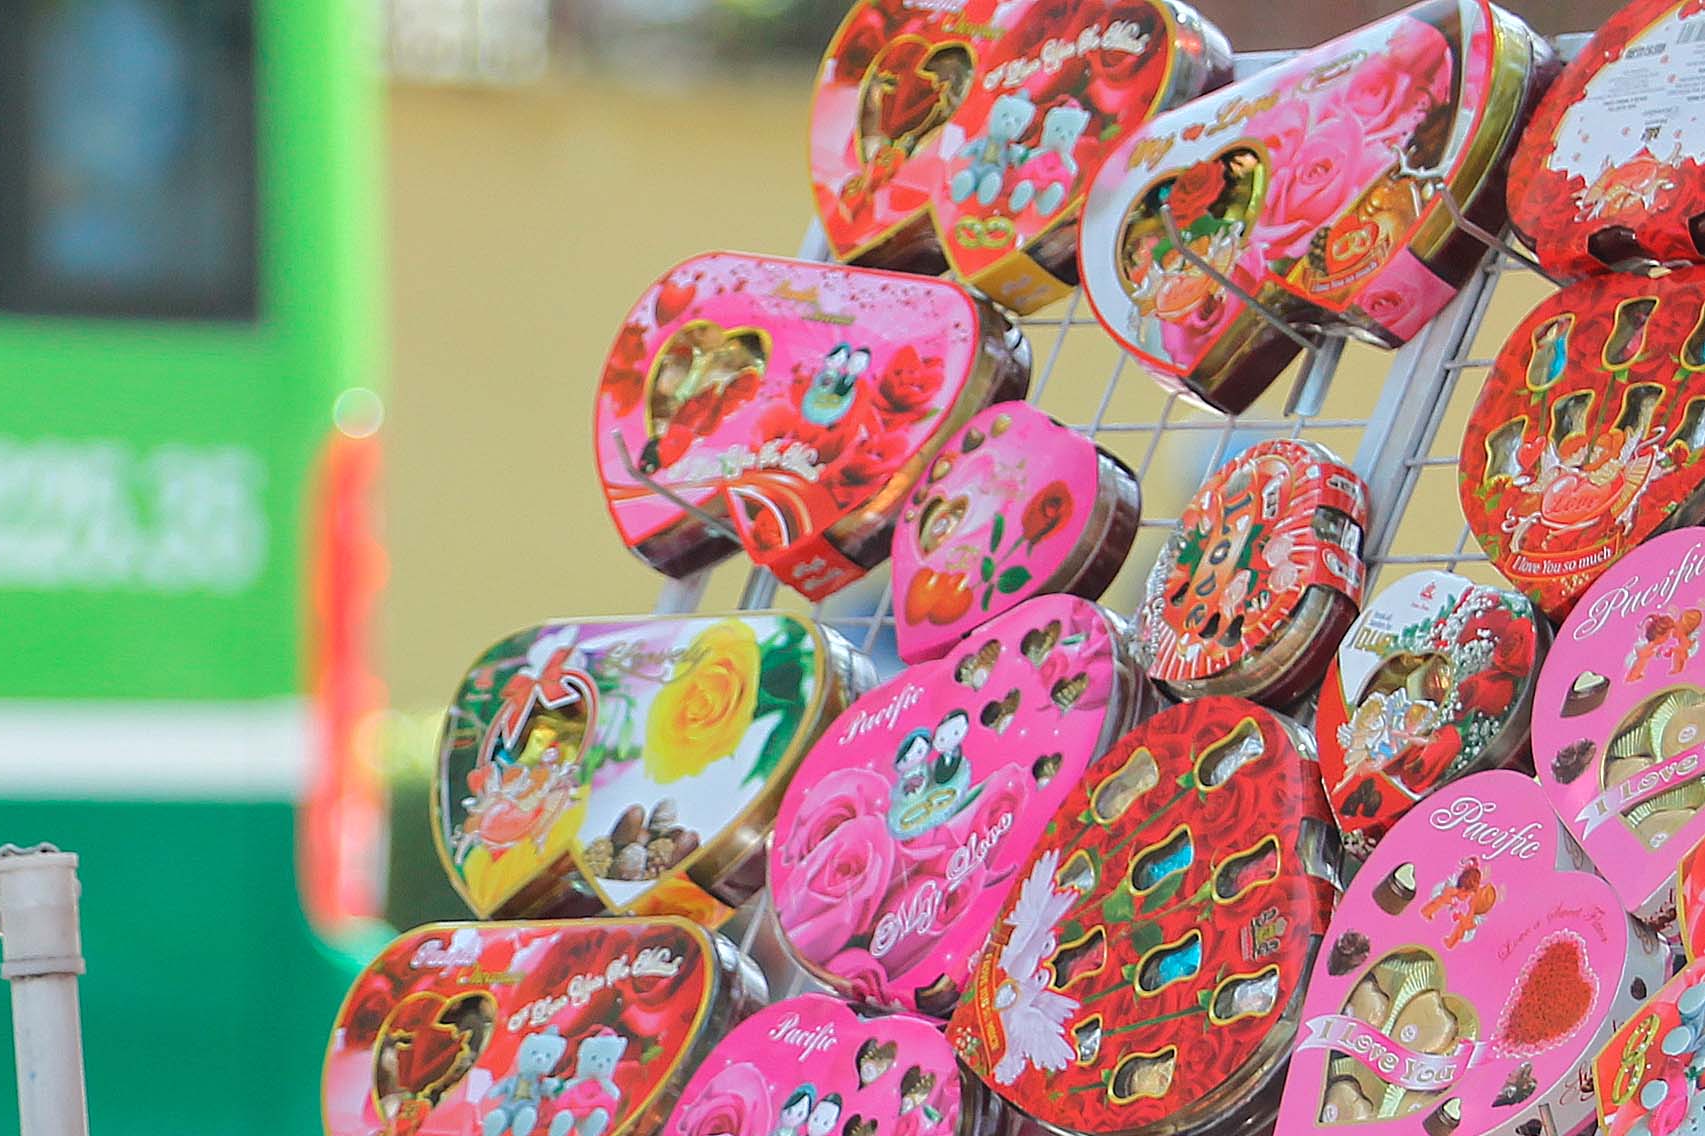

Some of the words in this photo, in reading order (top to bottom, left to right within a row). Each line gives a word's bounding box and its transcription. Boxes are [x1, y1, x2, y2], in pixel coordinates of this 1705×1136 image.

[1541, 559, 1562, 574] You
[1563, 560, 1577, 572] so
[1578, 547, 1612, 569] much
[838, 683, 925, 744] Pacific
[1429, 796, 1543, 860] Pacific
[769, 1010, 838, 1062] Pacific
[1338, 1025, 1398, 1071] Love
[1404, 1058, 1456, 1083] You
